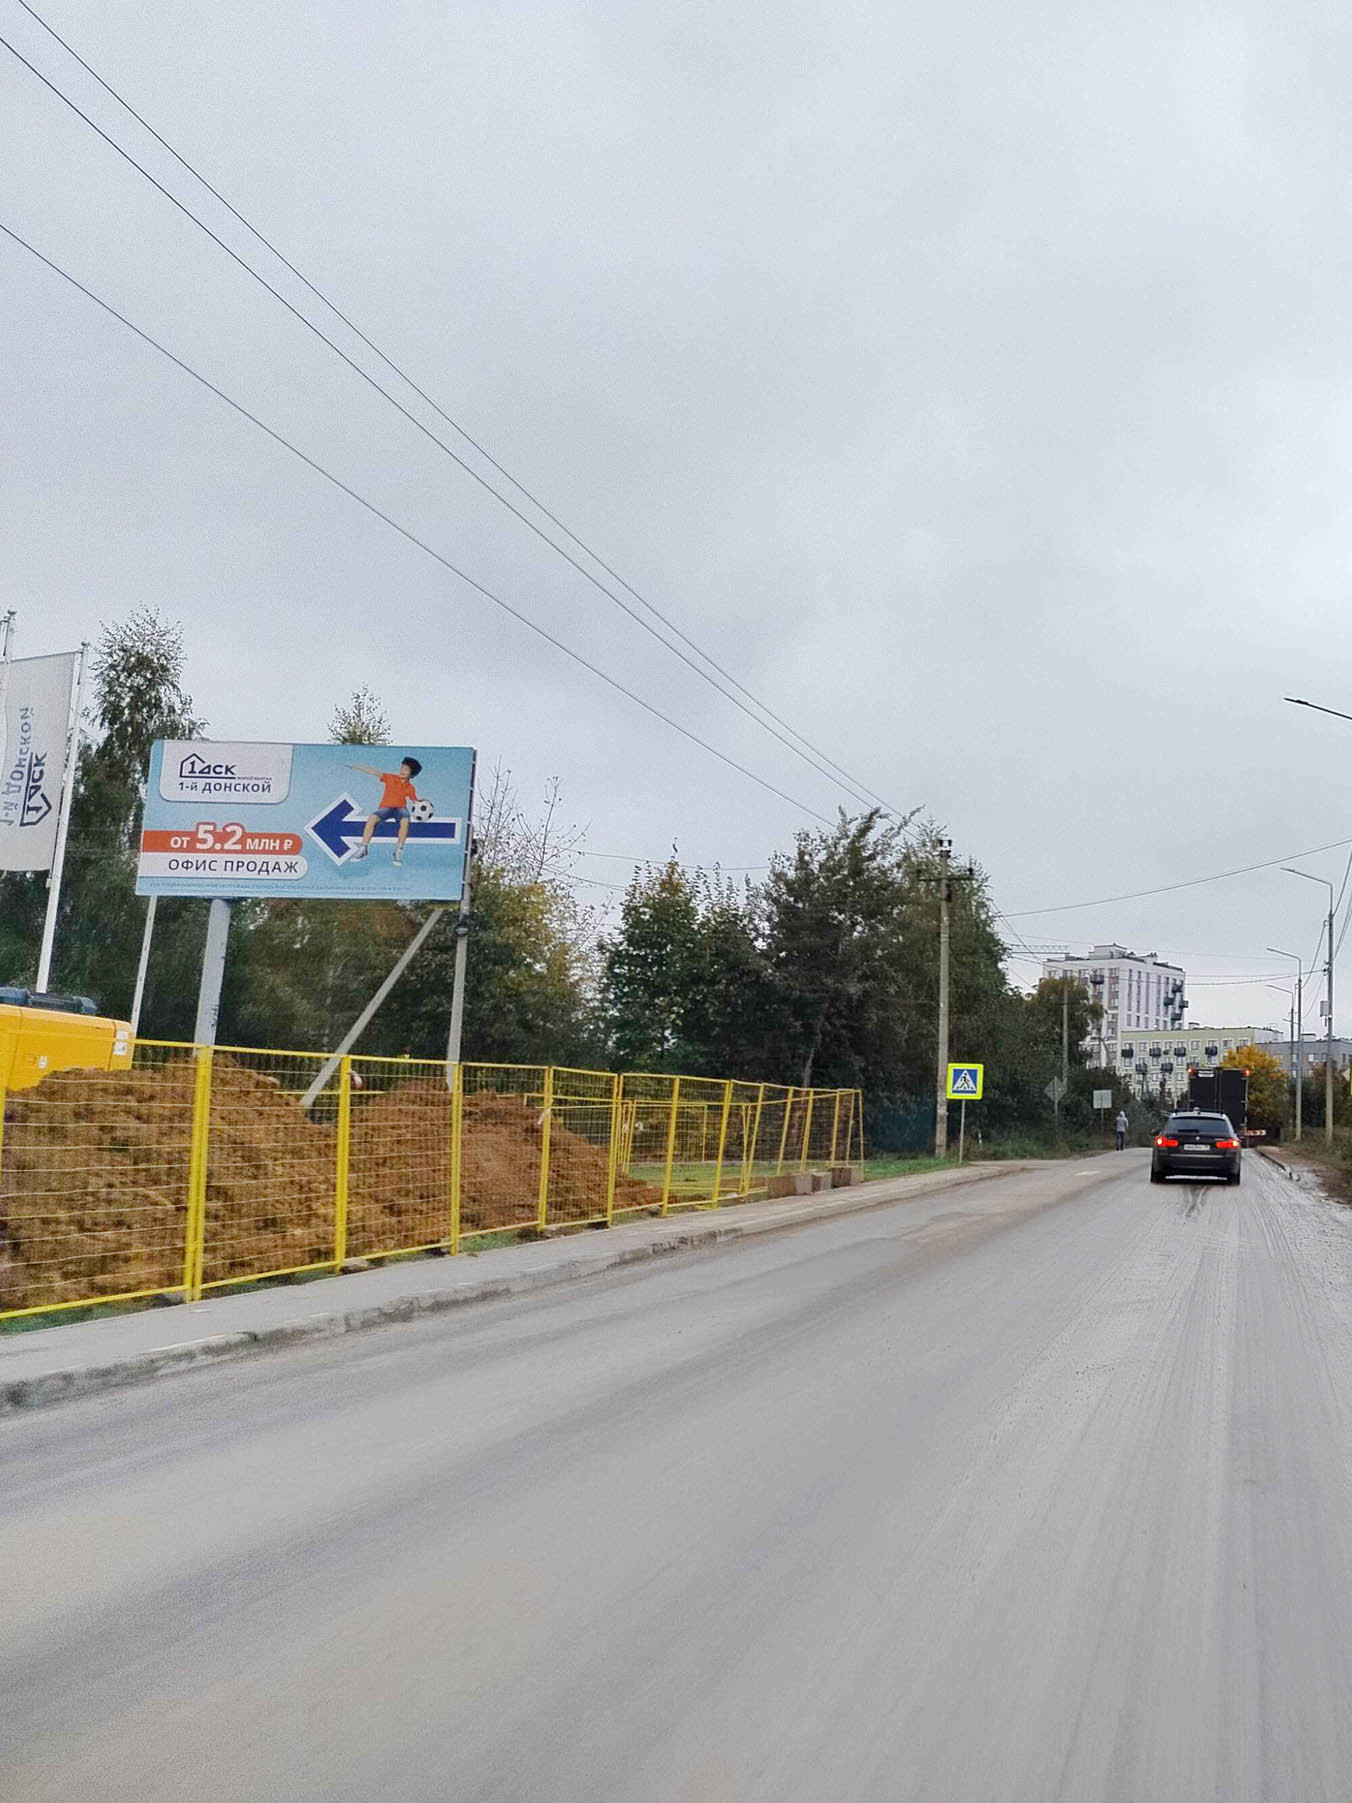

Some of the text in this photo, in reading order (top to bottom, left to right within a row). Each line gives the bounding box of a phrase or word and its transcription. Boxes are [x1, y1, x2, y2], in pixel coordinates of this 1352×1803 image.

[179, 780, 271, 794] 1-й ДОНСКОЙ
[195, 823, 243, 850] 5.2
[246, 838, 279, 851] МЛН
[168, 858, 299, 875] ОФИС ПРОДАЖ
